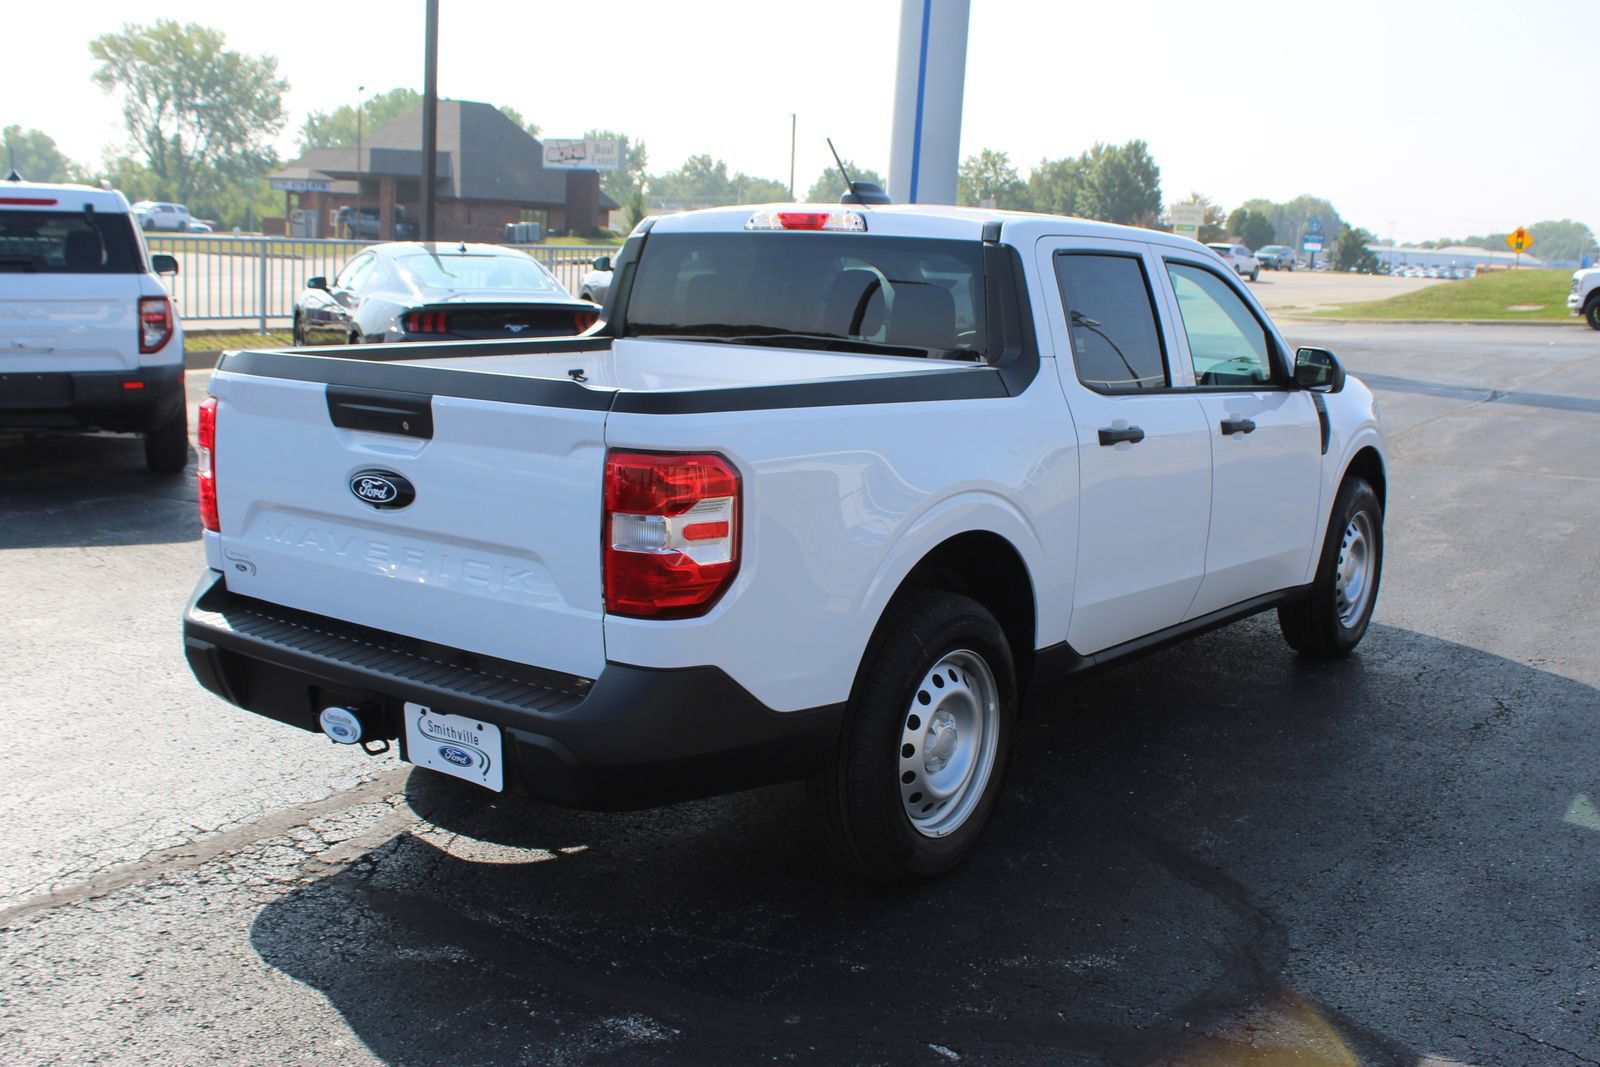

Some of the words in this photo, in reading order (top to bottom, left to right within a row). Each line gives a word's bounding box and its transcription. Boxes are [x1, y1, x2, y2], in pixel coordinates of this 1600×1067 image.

[359, 479, 388, 499] Ford
[428, 719, 479, 746] Smithville
[444, 749, 468, 764] Ford
